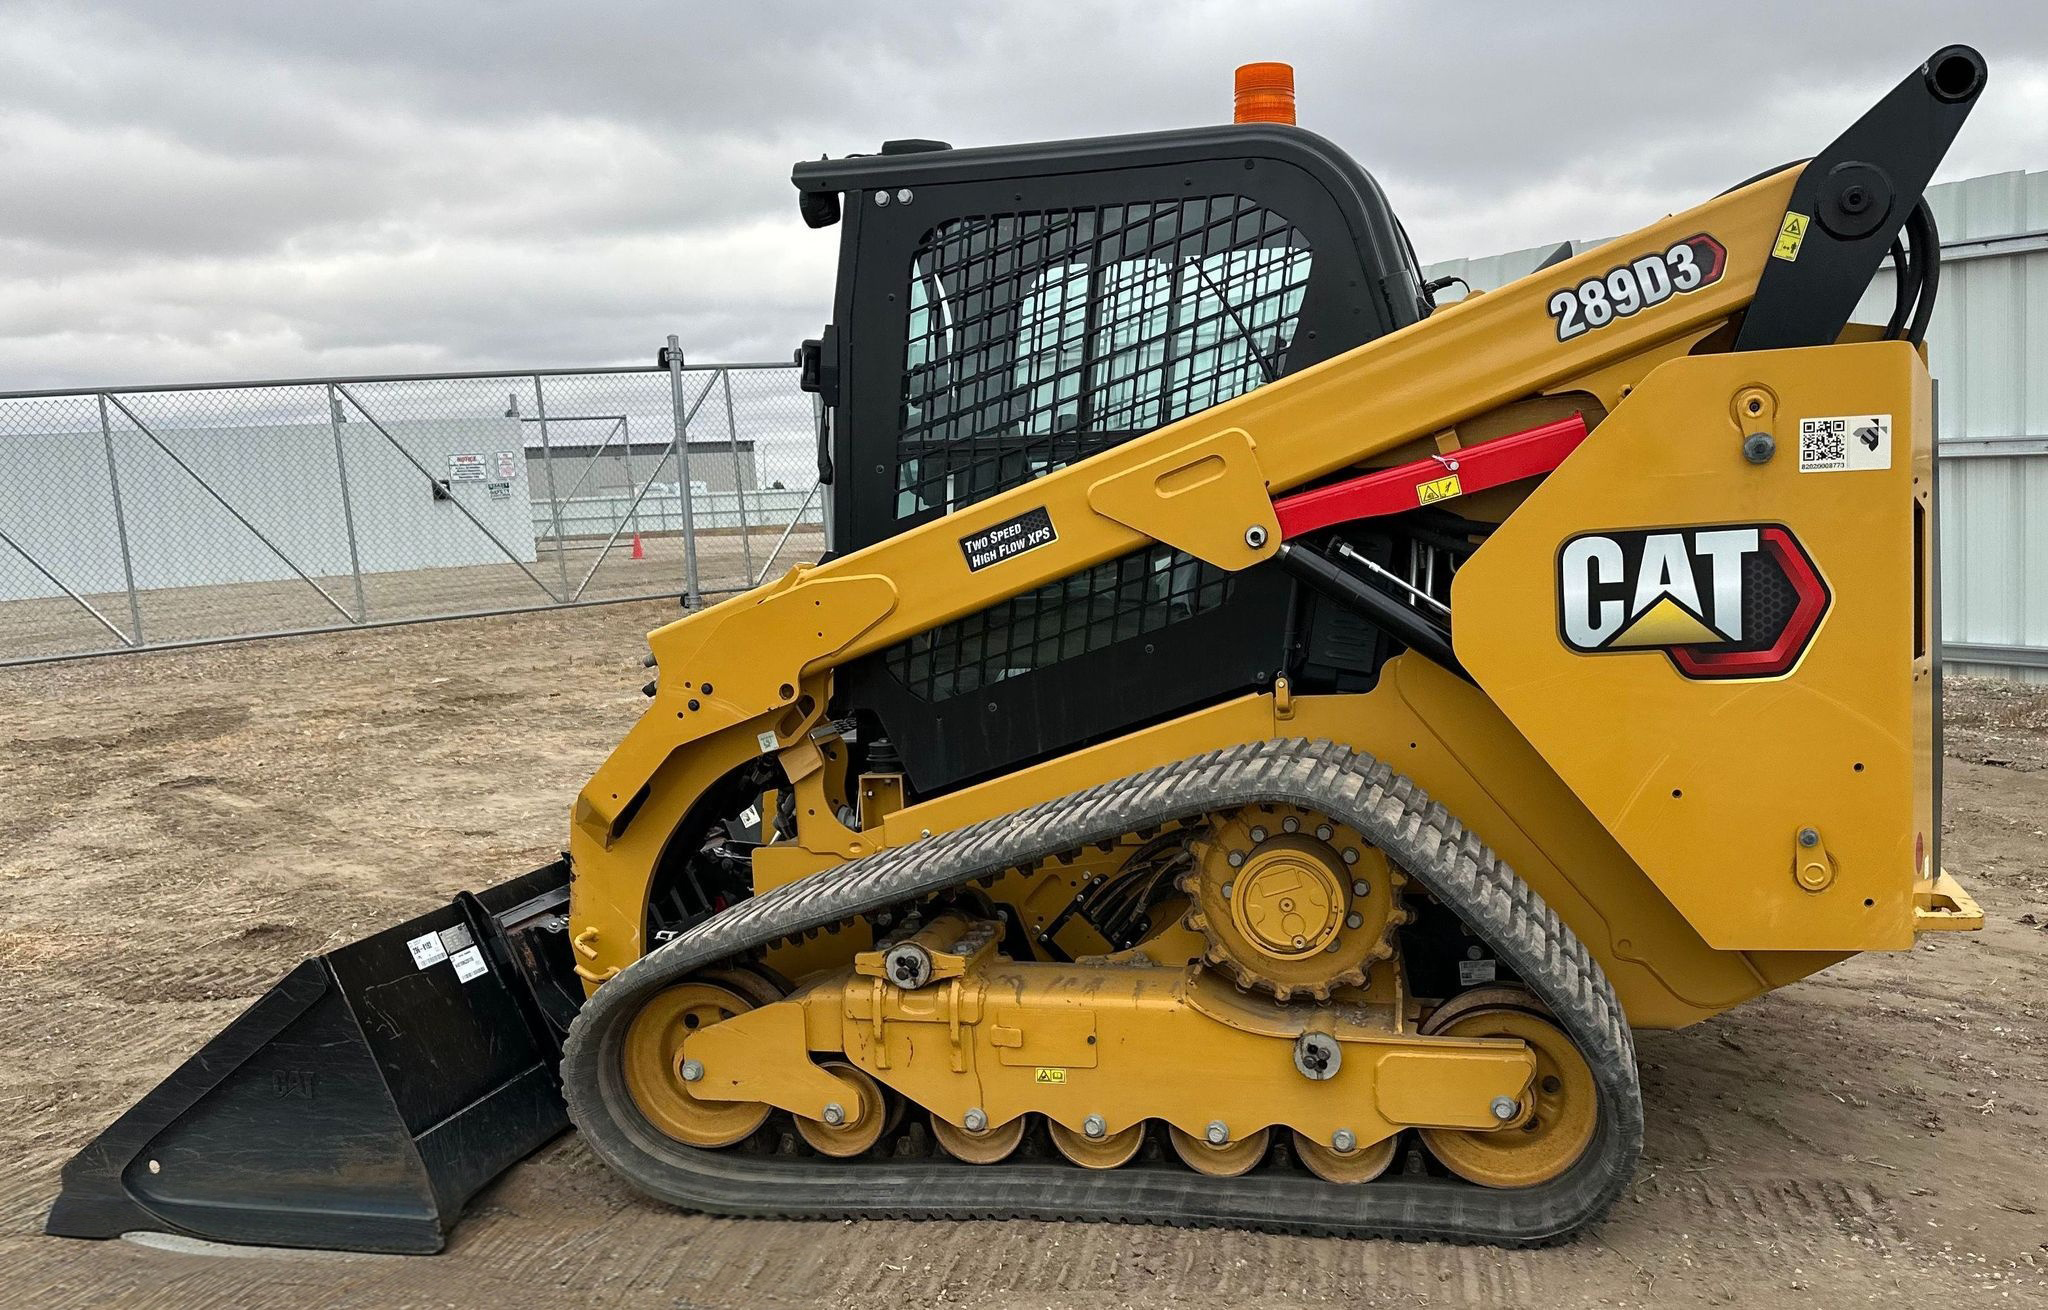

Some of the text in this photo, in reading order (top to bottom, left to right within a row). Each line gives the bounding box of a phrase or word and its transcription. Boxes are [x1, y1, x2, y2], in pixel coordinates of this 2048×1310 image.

[1550, 244, 1702, 340] 289D3
[964, 523, 1022, 554] TWO SPEED
[971, 526, 1051, 568] HIGH FLOW XPS
[1562, 528, 1759, 648] CAT
